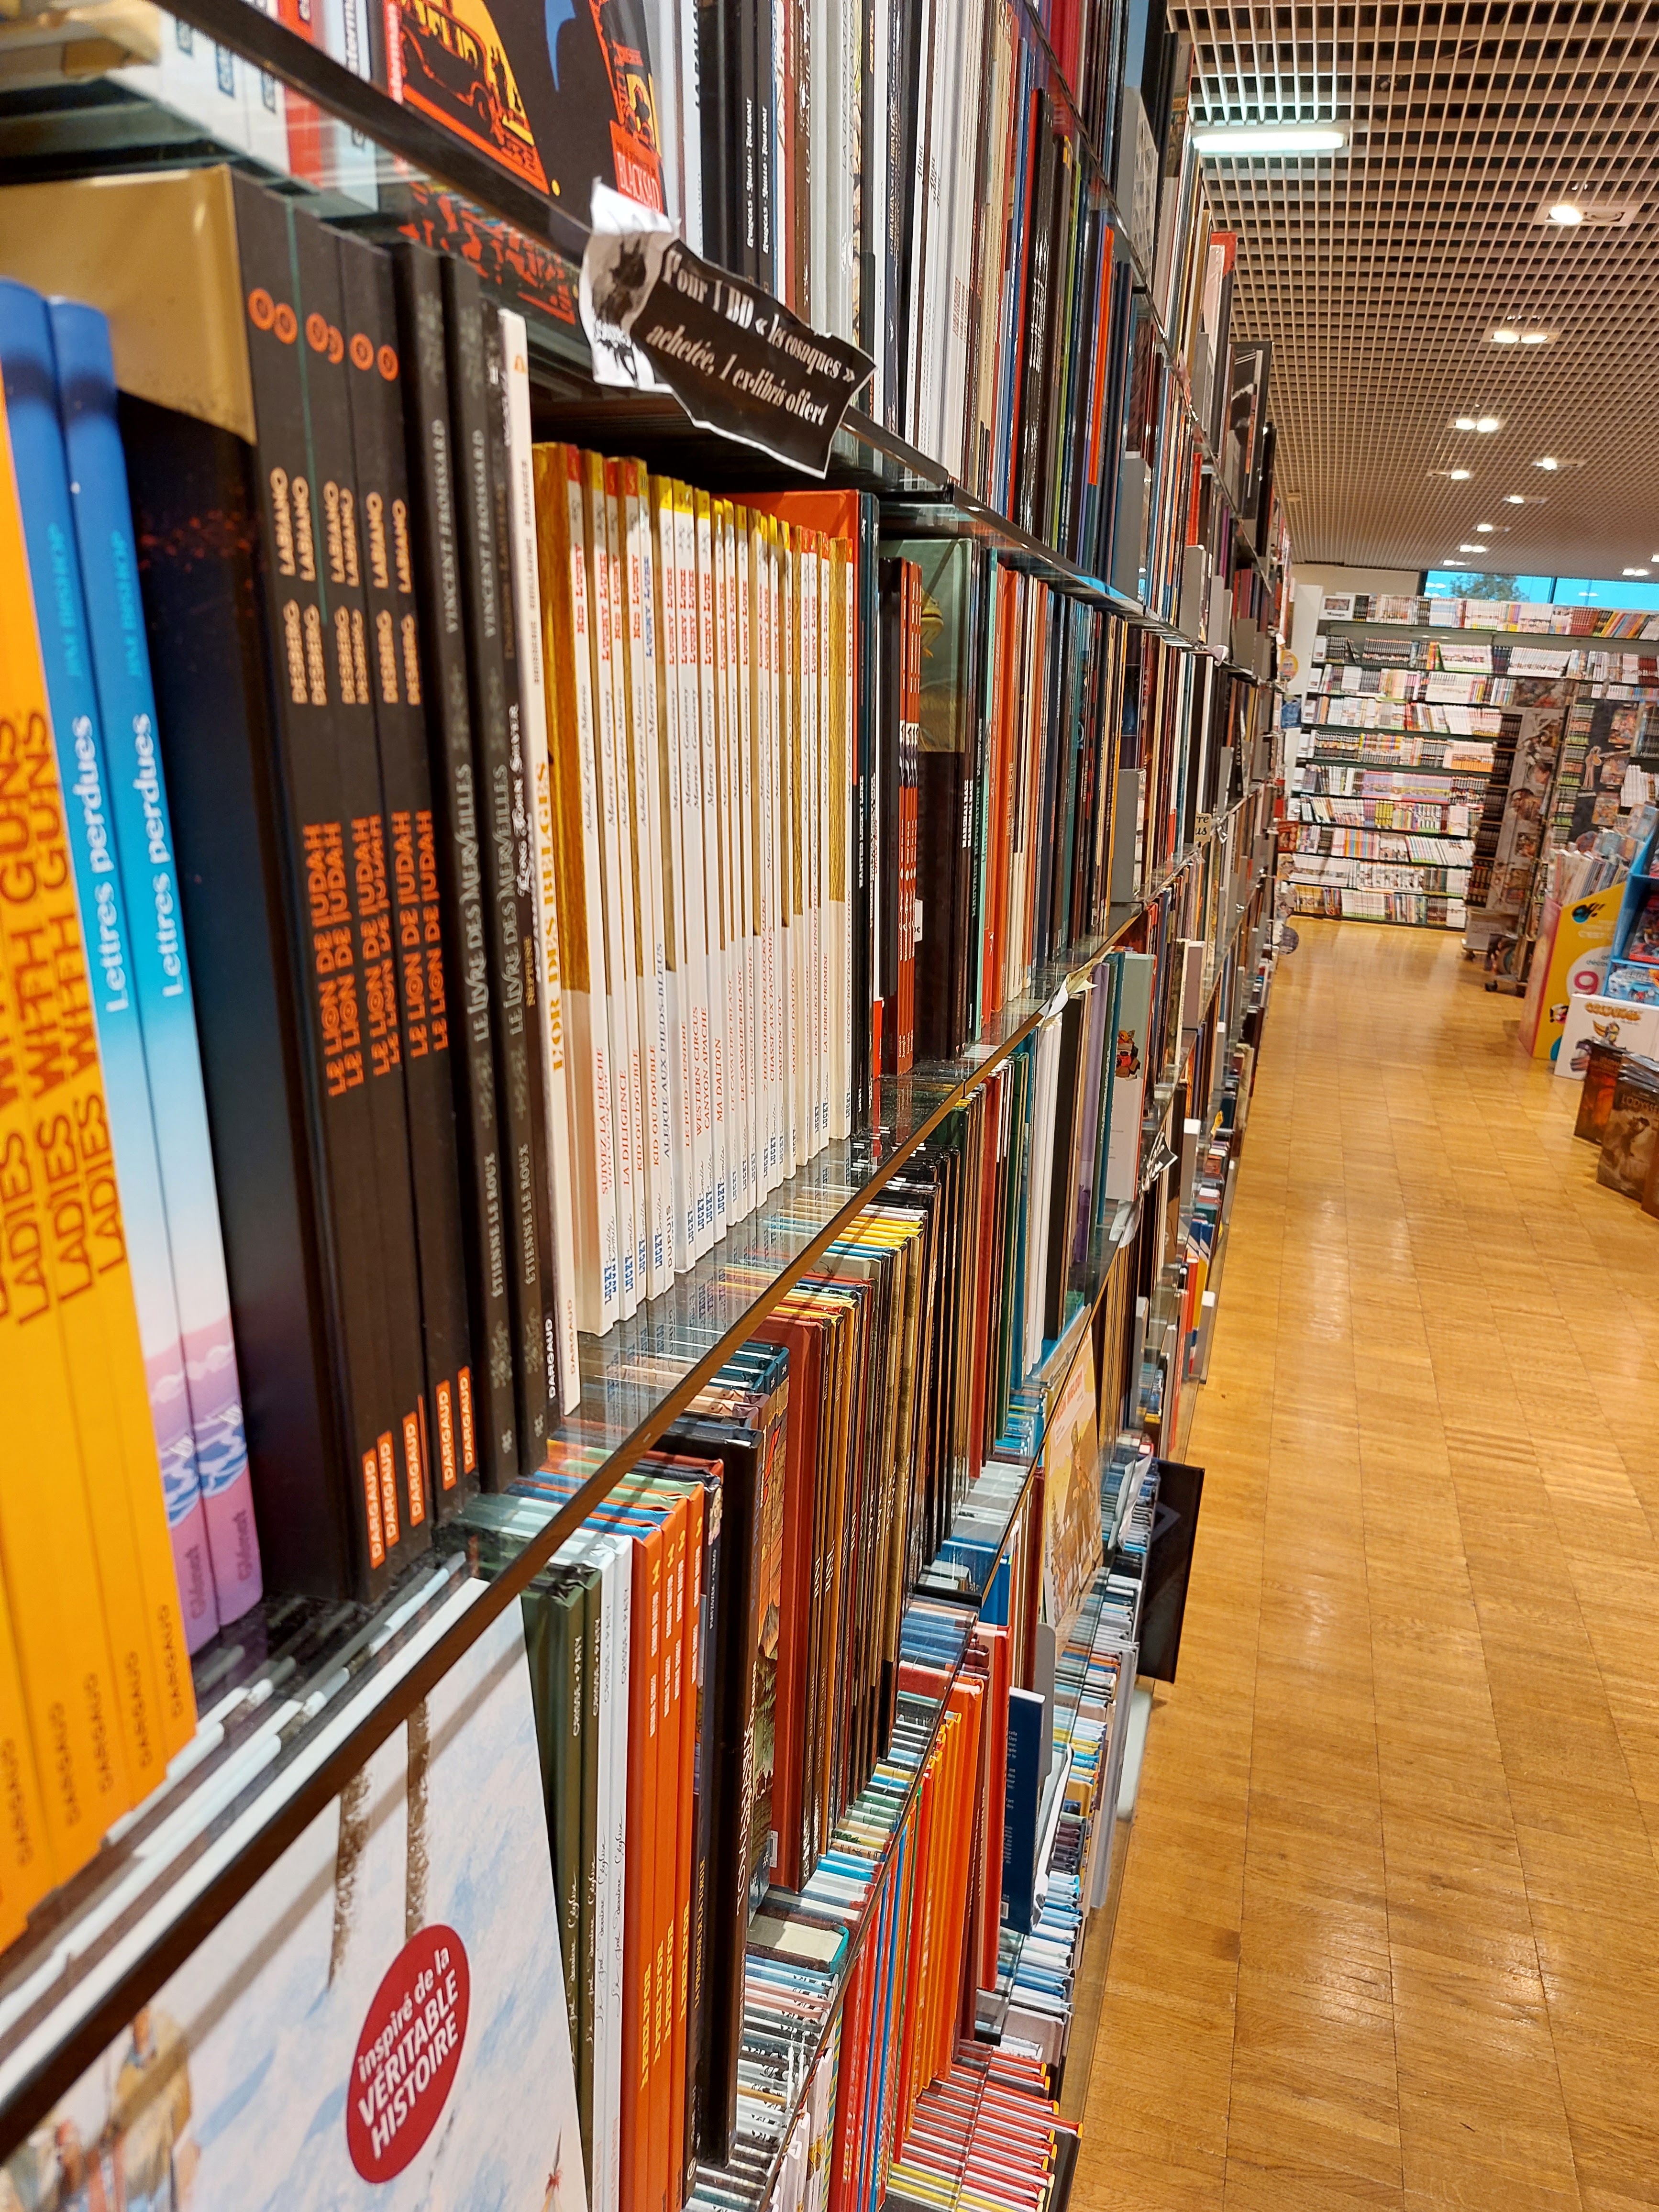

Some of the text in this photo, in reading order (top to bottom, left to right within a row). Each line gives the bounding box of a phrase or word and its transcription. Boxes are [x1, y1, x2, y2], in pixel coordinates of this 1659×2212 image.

[662, 245, 709, 303] Pour
[726, 286, 754, 329] BD
[768, 314, 783, 349] les
[784, 336, 841, 378] cosaques
[645, 324, 716, 376] achetée,
[785, 388, 830, 426] offert
[431, 419, 458, 633] VINCENT FROISSARD
[575, 543, 584, 597] LUCKY
[479, 545, 496, 638] VINCENT
[599, 553, 610, 661] LUCKY LUKE
[22, 710, 68, 890] GUNS
[536, 763, 555, 905] BELGES
[71, 714, 130, 1013] Lettres perdues
[132, 712, 184, 998] Lettres perdues
[455, 763, 490, 1041] LE LIVRE DES MERVEILLES
[492, 764, 523, 1036] LE LIVRE DES MERVEILLES
[303, 823, 347, 1096] LE LION DE JUDAH
[322, 821, 364, 1087] LE LION DE JUDAH
[391, 811, 428, 1058] LE LION DE JUDAH
[523, 935, 535, 1007] NEPTUNE
[545, 917, 558, 983] DES
[49, 911, 96, 1083] WITH
[656, 943, 666, 1054] PIEDS-BLEUS
[11, 927, 93, 1303] LADIES WITH
[619, 1070, 630, 1186] LA DILIGENCE
[649, 1044, 657, 1114] DOUBLE
[652, 1117, 658, 1134] OU
[662, 1096, 670, 1158] ALERTE
[702, 1070, 710, 1129] CANYON
[714, 1039, 723, 1123] MA DALTON
[74, 1093, 126, 1276] LADIES
[484, 1152, 498, 1200] ROUX
[487, 1201, 498, 1224] LE
[519, 1144, 531, 1190] ROUX
[521, 1191, 531, 1213] LE
[600, 1139, 609, 1195] SUIVEZ
[0, 1130, 50, 1327] LADIES
[625, 1255, 633, 1293] LUCKY
[545, 1319, 556, 1399] DARGAUD
[406, 1422, 422, 1517] DARGAUD
[439, 1391, 453, 1482] DARGAUD
[460, 1377, 474, 1464] DARGAUD
[365, 1459, 381, 1559] DARGAUD
[380, 1443, 396, 1538] DARGAUD
[357, 1947, 450, 2083] inspiré de la
[642, 1963, 652, 2022] D'OR
[655, 1939, 664, 1997] D'OR
[359, 1969, 458, 2127] VÉRITABLE
[371, 2011, 458, 2160] HISTOIRE
